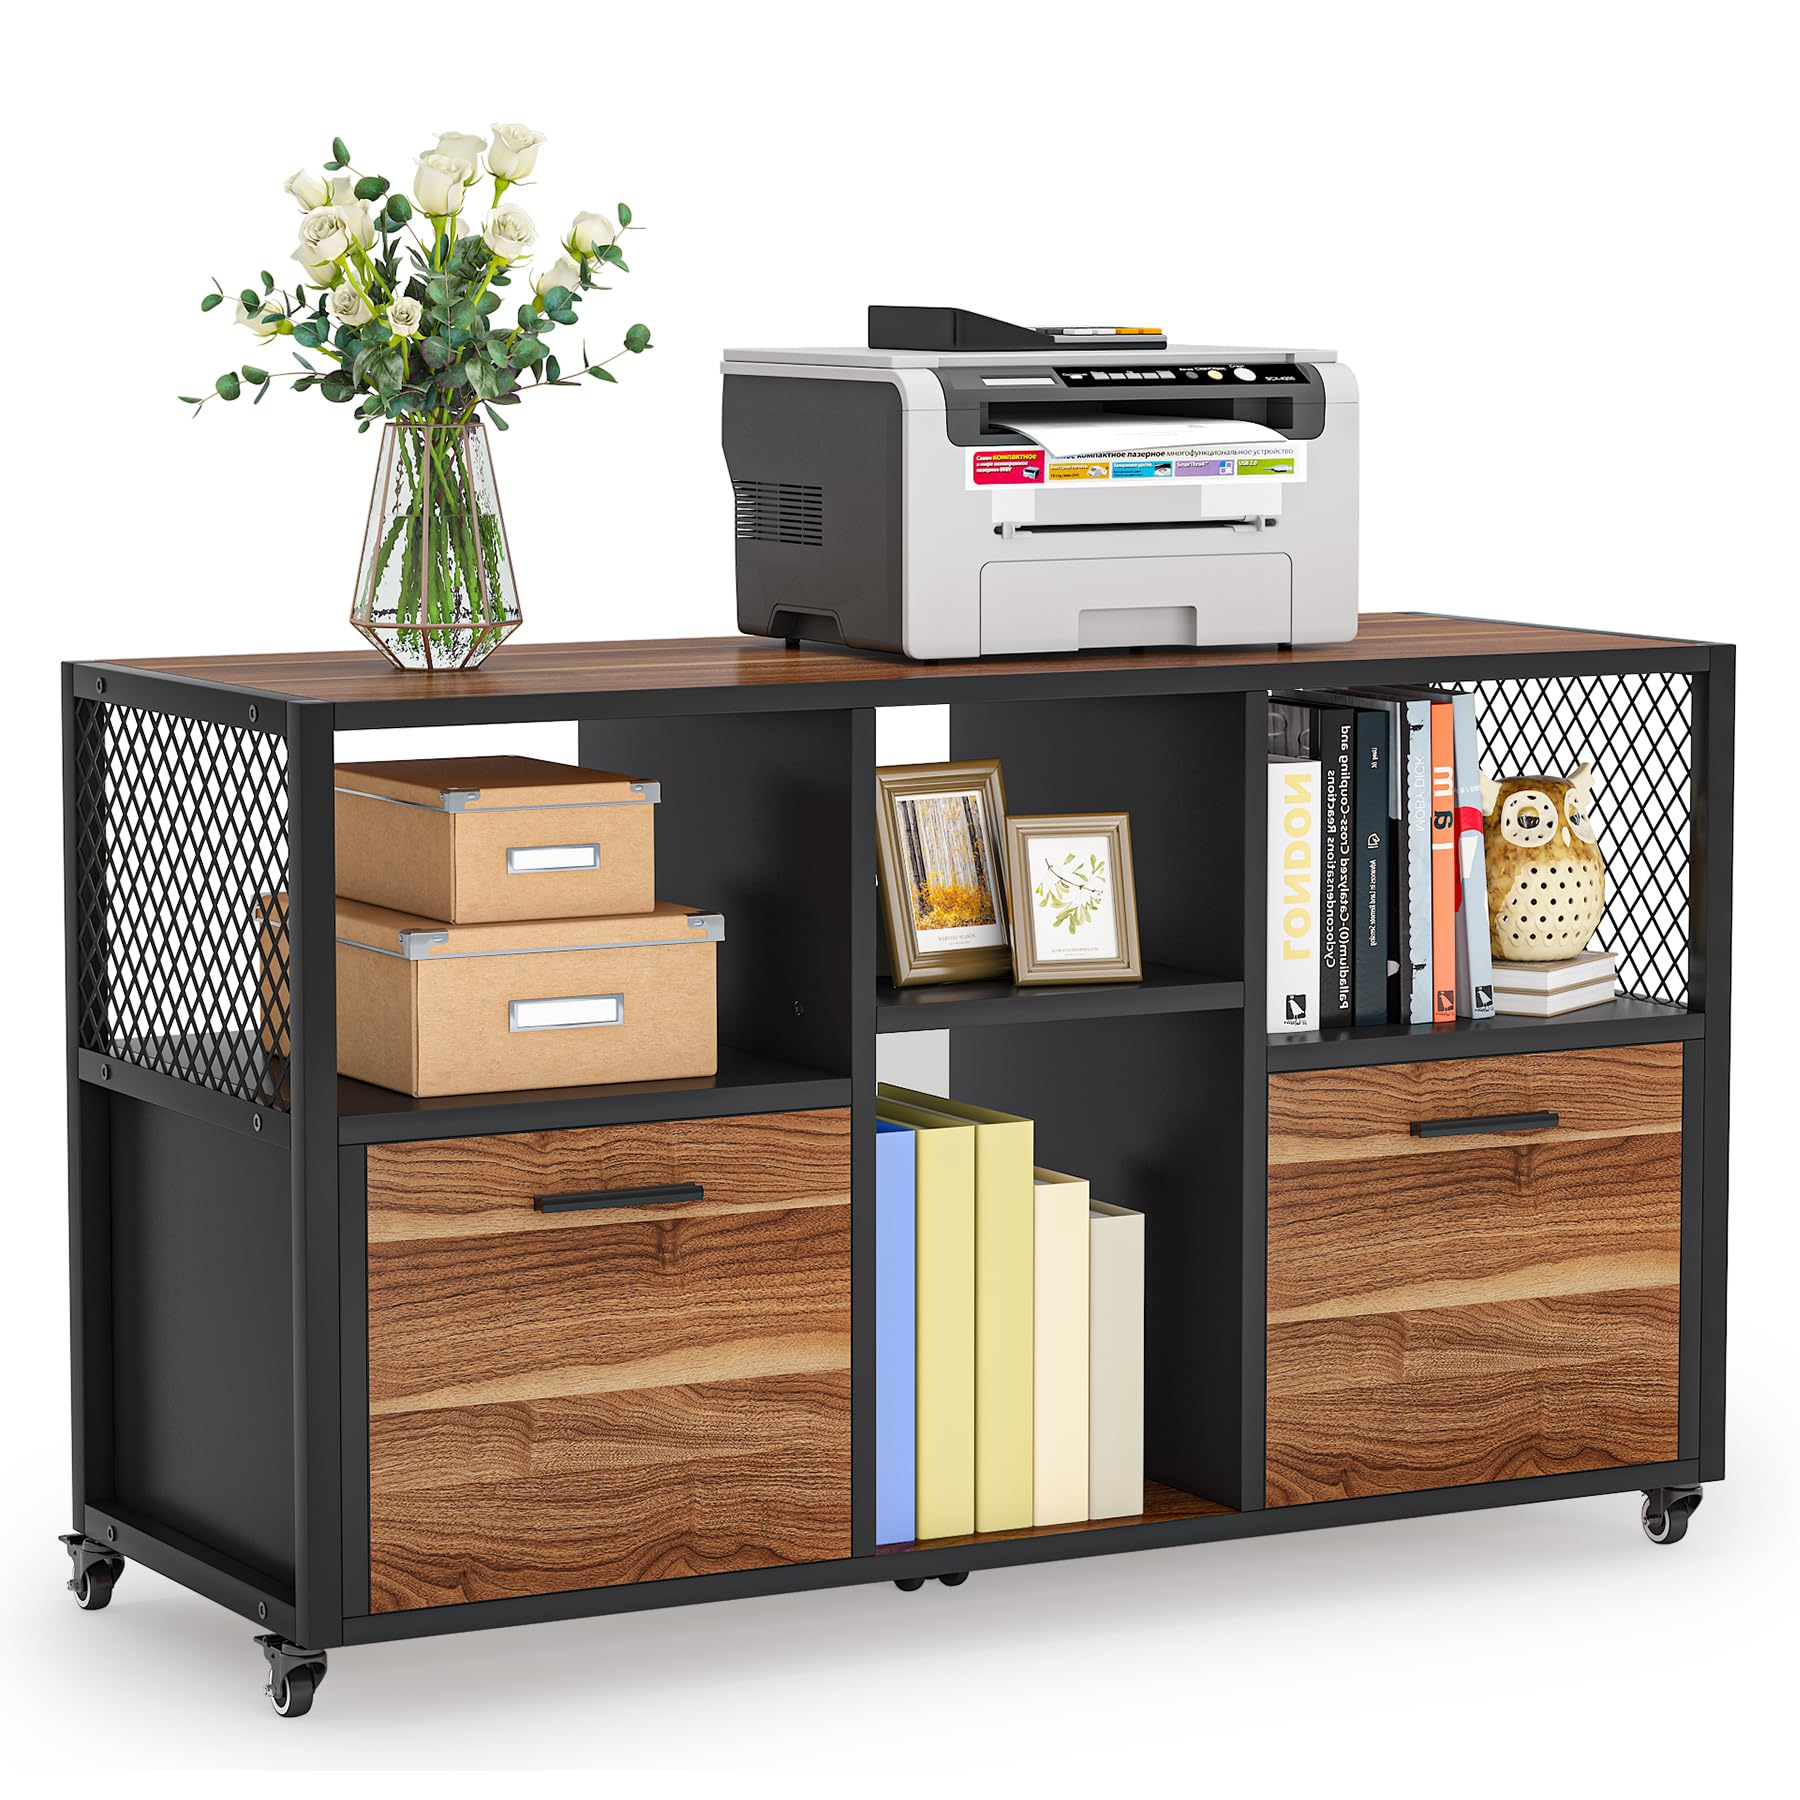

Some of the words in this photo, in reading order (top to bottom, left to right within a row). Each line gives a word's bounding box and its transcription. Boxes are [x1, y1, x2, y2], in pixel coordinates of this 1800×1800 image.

[1127, 450, 1166, 460] лазерное
[1166, 448, 1252, 458] многофункциональное
[1252, 447, 1294, 457] устройство
